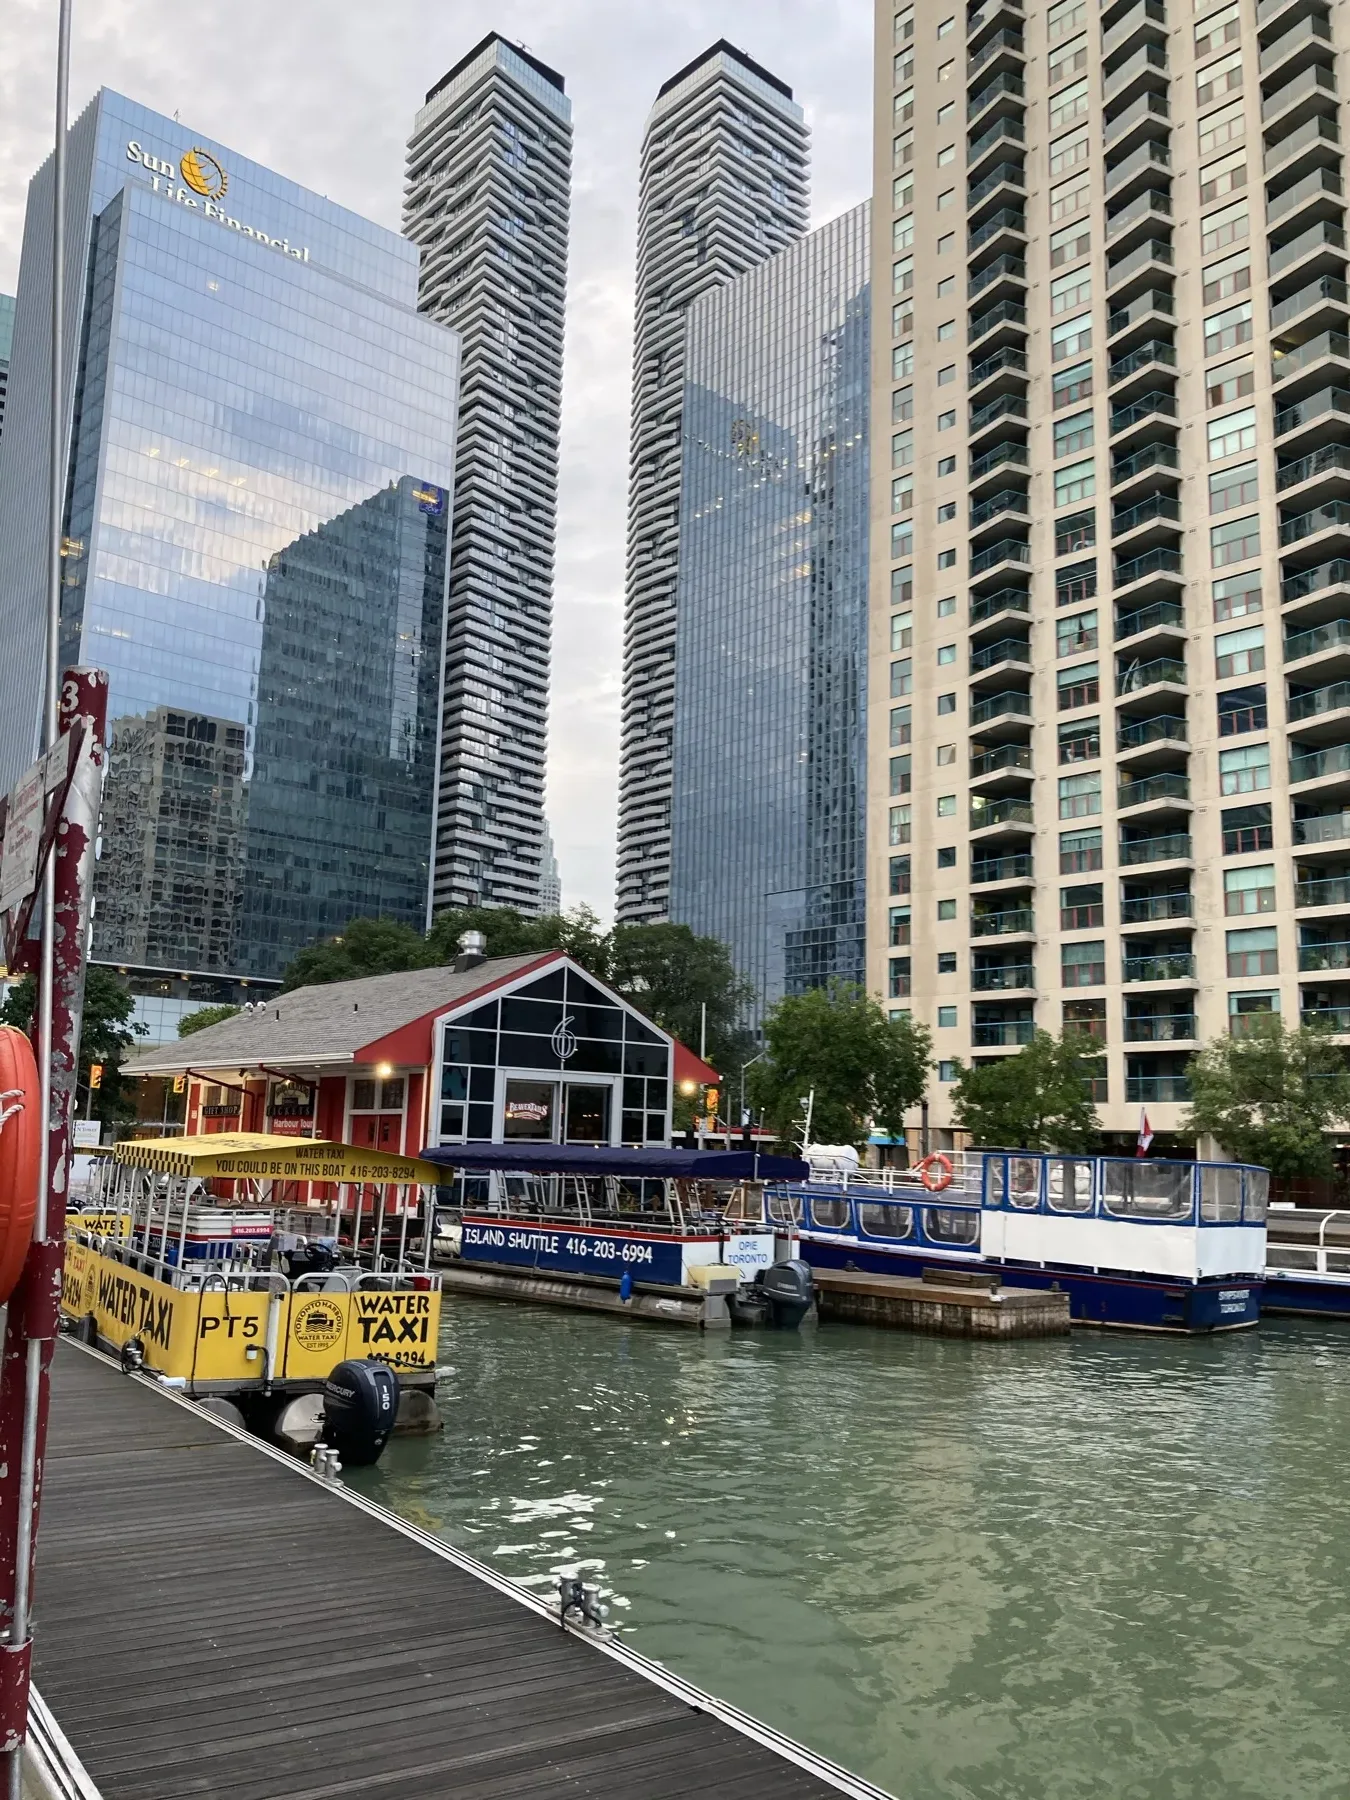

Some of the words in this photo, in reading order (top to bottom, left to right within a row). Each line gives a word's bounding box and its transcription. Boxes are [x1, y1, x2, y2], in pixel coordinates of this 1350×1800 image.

[126, 141, 175, 180] Sun
[61, 680, 79, 712] 3
[204, 1106, 219, 1115] GIFT
[220, 1105, 238, 1114] SHOP
[266, 1105, 311, 1116] TICKETS
[273, 1118, 299, 1128] Harbour
[295, 1147, 325, 1159] WATER
[326, 1148, 345, 1159] TAXI
[216, 1159, 234, 1172] YOU
[237, 1160, 267, 1174] COULD
[270, 1162, 282, 1174] BE
[284, 1162, 297, 1175] ON
[300, 1163, 320, 1176] THIS
[322, 1164, 346, 1177] BOAT
[350, 1164, 415, 1179] 416-203-8294
[464, 1228, 505, 1246] ISLAND
[507, 1232, 560, 1254] SHUTTLE
[566, 1237, 653, 1264] 416-203-6994
[739, 1241, 758, 1251] OPIE
[728, 1253, 767, 1264] TORONTO
[99, 1268, 137, 1329] WATER
[139, 1286, 174, 1351] TAXI
[360, 1295, 430, 1315] WATER
[200, 1316, 259, 1339] PT5
[295, 1301, 321, 1335] TORONTO
[321, 1301, 342, 1333] HARBOUR
[357, 1316, 429, 1343] TAXI
[325, 1381, 356, 1398] MERCURY
[382, 1384, 390, 1411] 150
